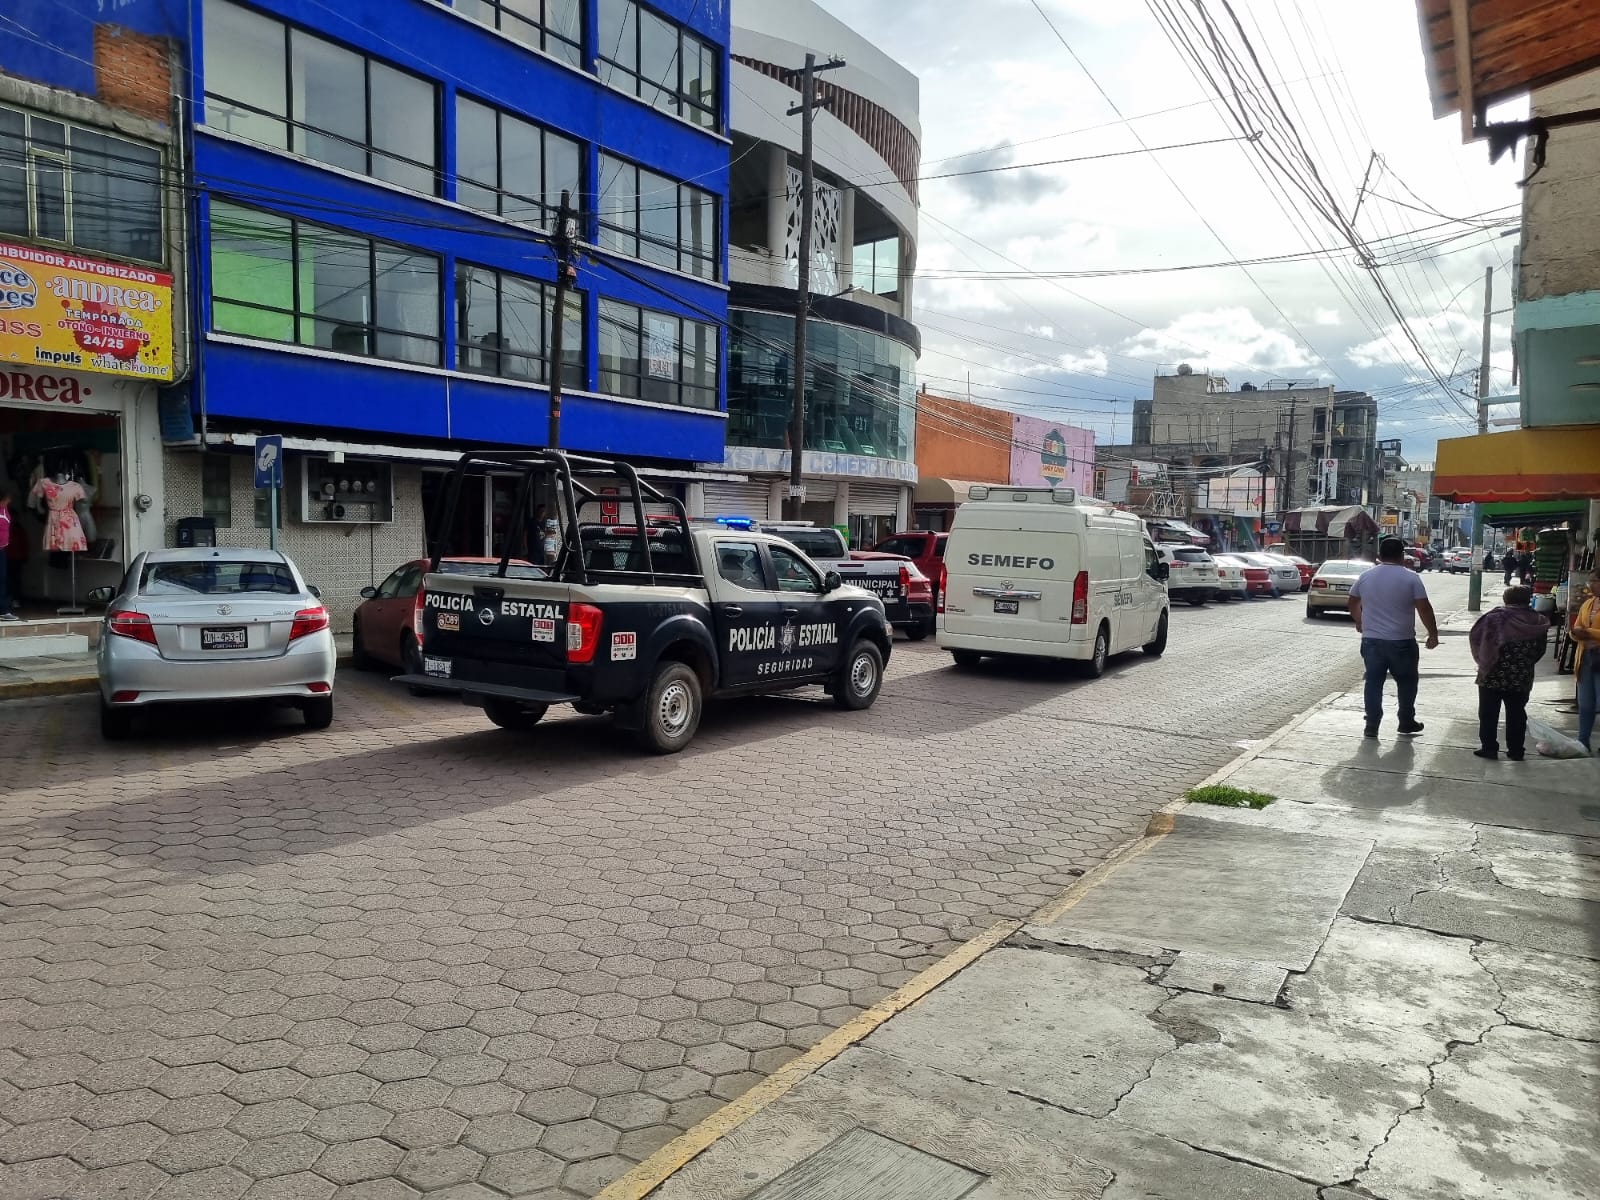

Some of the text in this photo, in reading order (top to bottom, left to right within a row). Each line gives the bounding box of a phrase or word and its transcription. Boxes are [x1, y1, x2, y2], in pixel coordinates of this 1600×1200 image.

[0, 246, 156, 283] IBUIDOR AUTORIZADO
[66, 308, 143, 328] TEMPORADA
[83, 335, 125, 349] 24/25
[101, 327, 150, 341] INVIERNO
[35, 346, 82, 363] impuls
[91, 356, 168, 376] whatshome
[967, 553, 1055, 570] SEMEFO
[845, 579, 899, 589] MUNICIPAL
[425, 593, 563, 620] POLICÍA ESTATAL
[613, 634, 635, 645] 911
[729, 621, 838, 652] POLICÍA ESTATAL
[757, 657, 813, 675] SEGURIDAD
